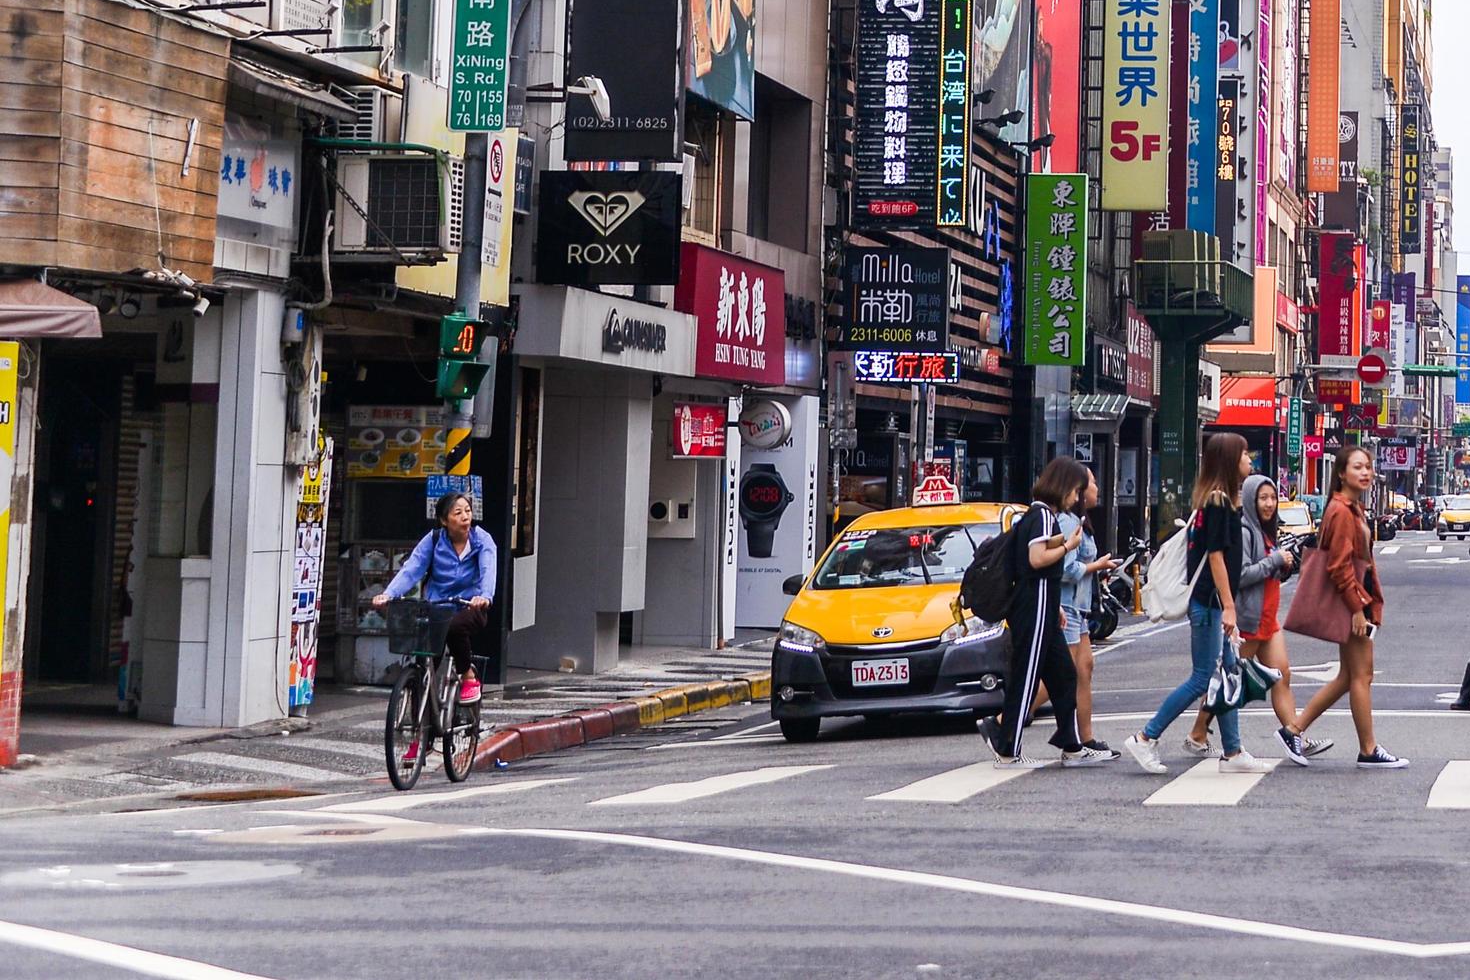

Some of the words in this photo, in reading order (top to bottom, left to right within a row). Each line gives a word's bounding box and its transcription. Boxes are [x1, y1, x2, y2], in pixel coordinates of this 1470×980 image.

[456, 54, 504, 70] XiNing
[456, 72, 470, 85] S.
[474, 72, 499, 85] Rd.
[457, 90, 472, 103] 70
[481, 91, 503, 104] 155
[456, 113, 471, 126] 76
[480, 113, 502, 127] 169
[572, 115, 669, 131] (02)2311-6825
[1109, 121, 1163, 163] 5F
[1404, 154, 1418, 233] HOTEL
[870, 201, 915, 215] 吃到飽6F
[567, 243, 642, 265] ROXY
[861, 253, 914, 283] Milla
[915, 267, 942, 284] Hotel
[716, 265, 767, 346] 新東陽
[850, 327, 912, 343] 2311-6006
[915, 329, 938, 343] 休息
[1127, 316, 1140, 355] U2
[714, 342, 732, 365] HSIN
[732, 345, 750, 368] TUNG
[750, 348, 767, 371] YANG
[928, 480, 944, 490] M
[916, 490, 955, 503] 大都會
[853, 663, 909, 684] TDA-2313
